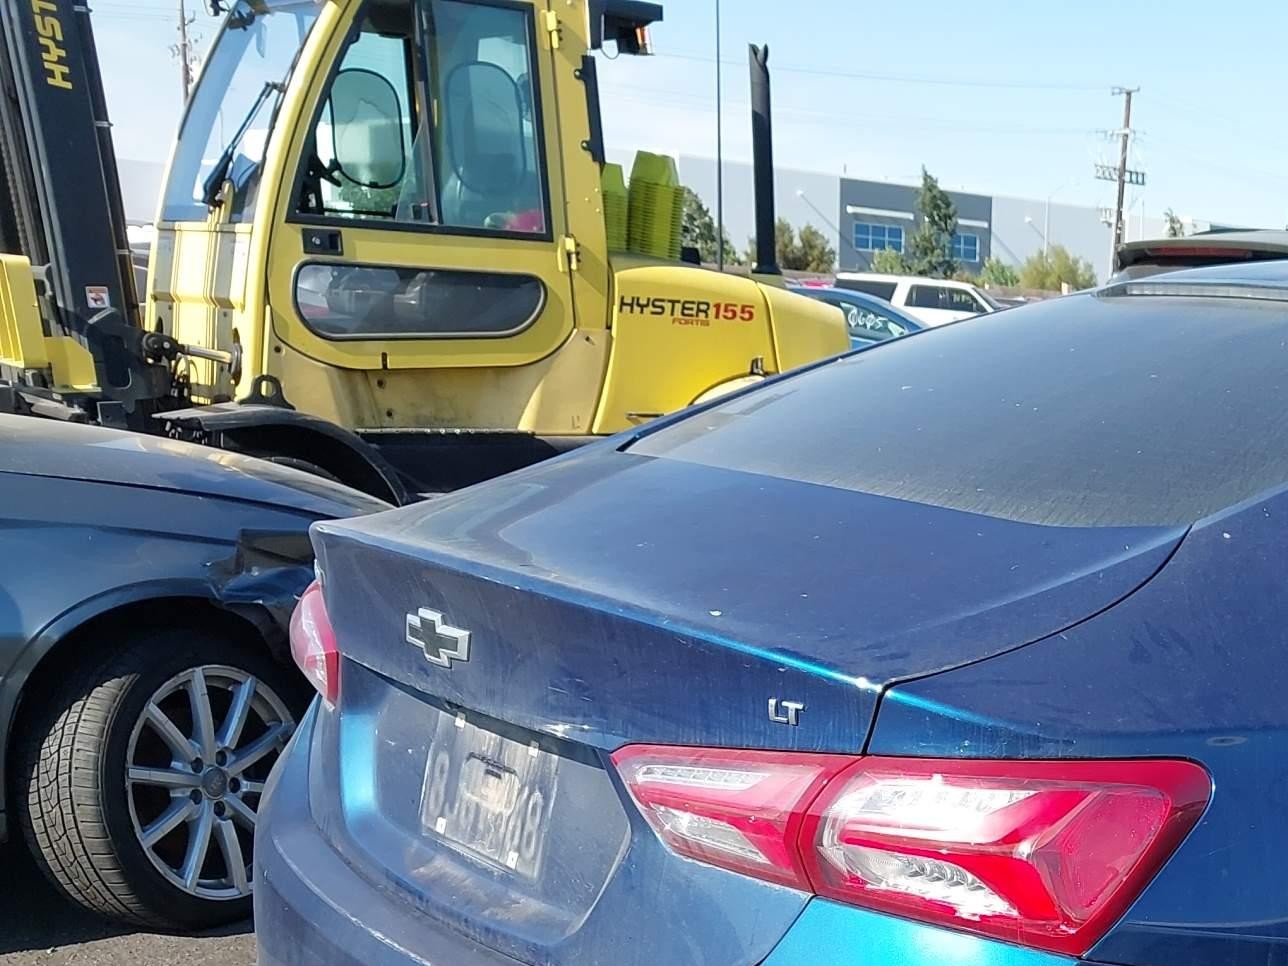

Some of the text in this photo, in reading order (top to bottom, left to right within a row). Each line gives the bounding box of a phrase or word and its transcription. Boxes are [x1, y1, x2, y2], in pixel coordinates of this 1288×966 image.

[619, 295, 754, 321] HYSTER 155
[767, 697, 805, 726] LT
